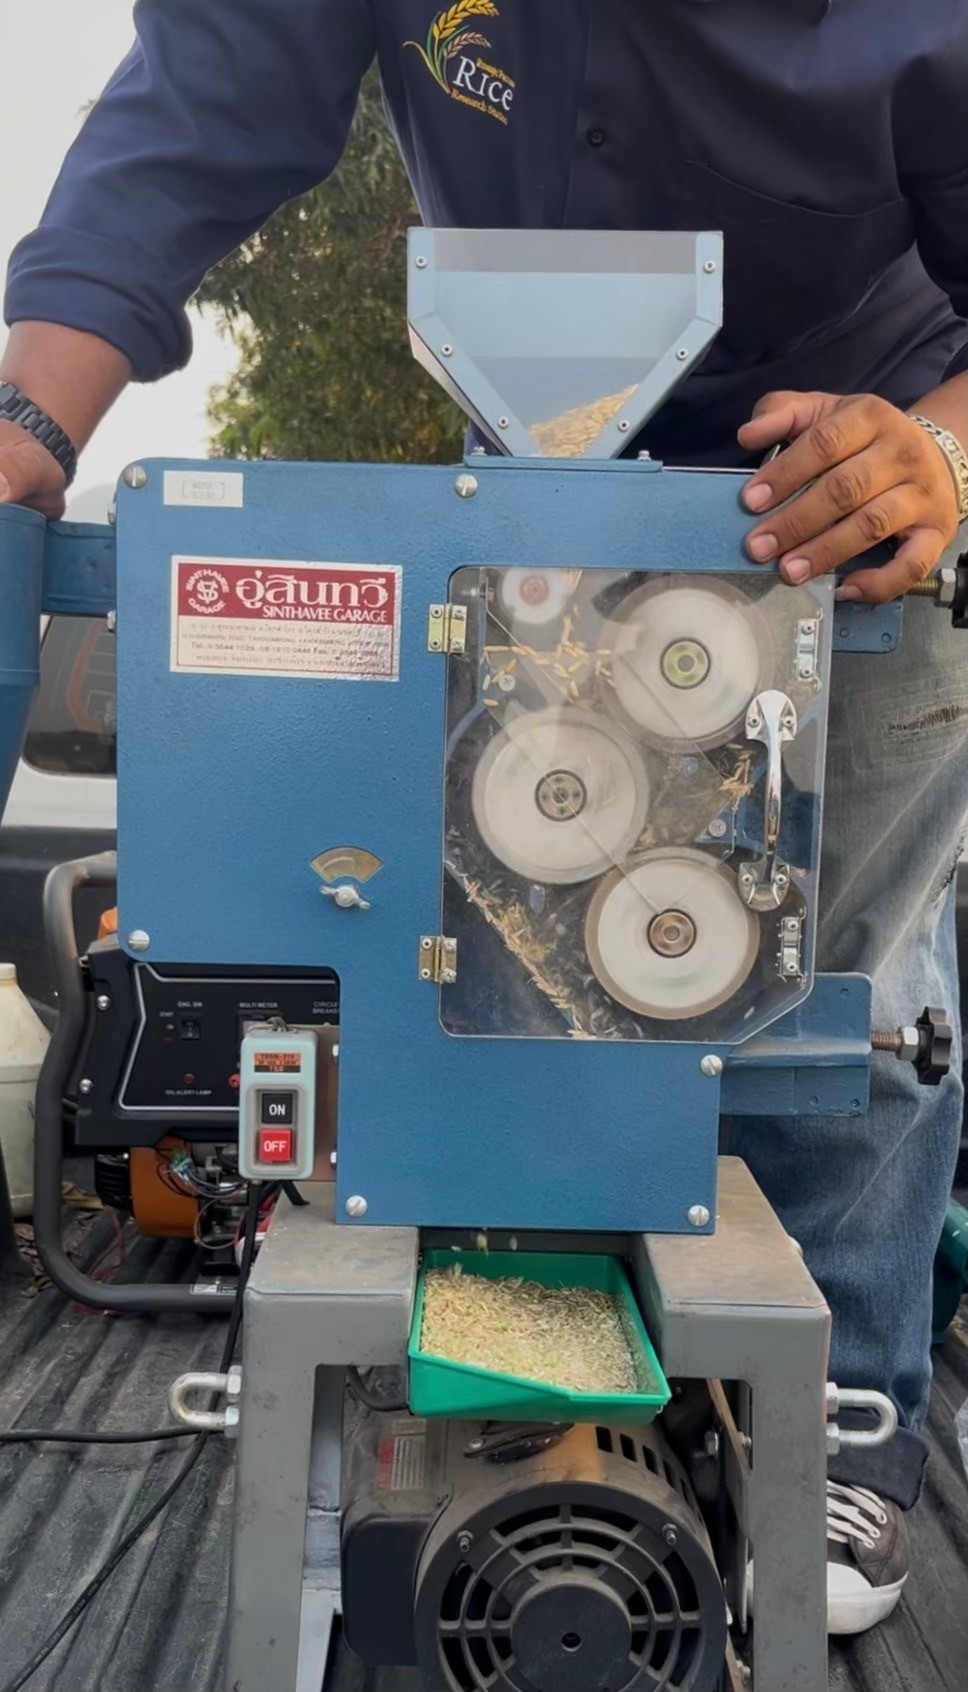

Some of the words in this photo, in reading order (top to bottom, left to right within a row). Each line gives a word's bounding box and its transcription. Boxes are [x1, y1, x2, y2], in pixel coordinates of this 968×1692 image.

[188, 597, 226, 614] GARAGE
[263, 605, 332, 621] SINTHAVEE
[333, 607, 388, 623] GARAGE
[269, 1104, 286, 1116] ON
[263, 1140, 287, 1152] OFF
